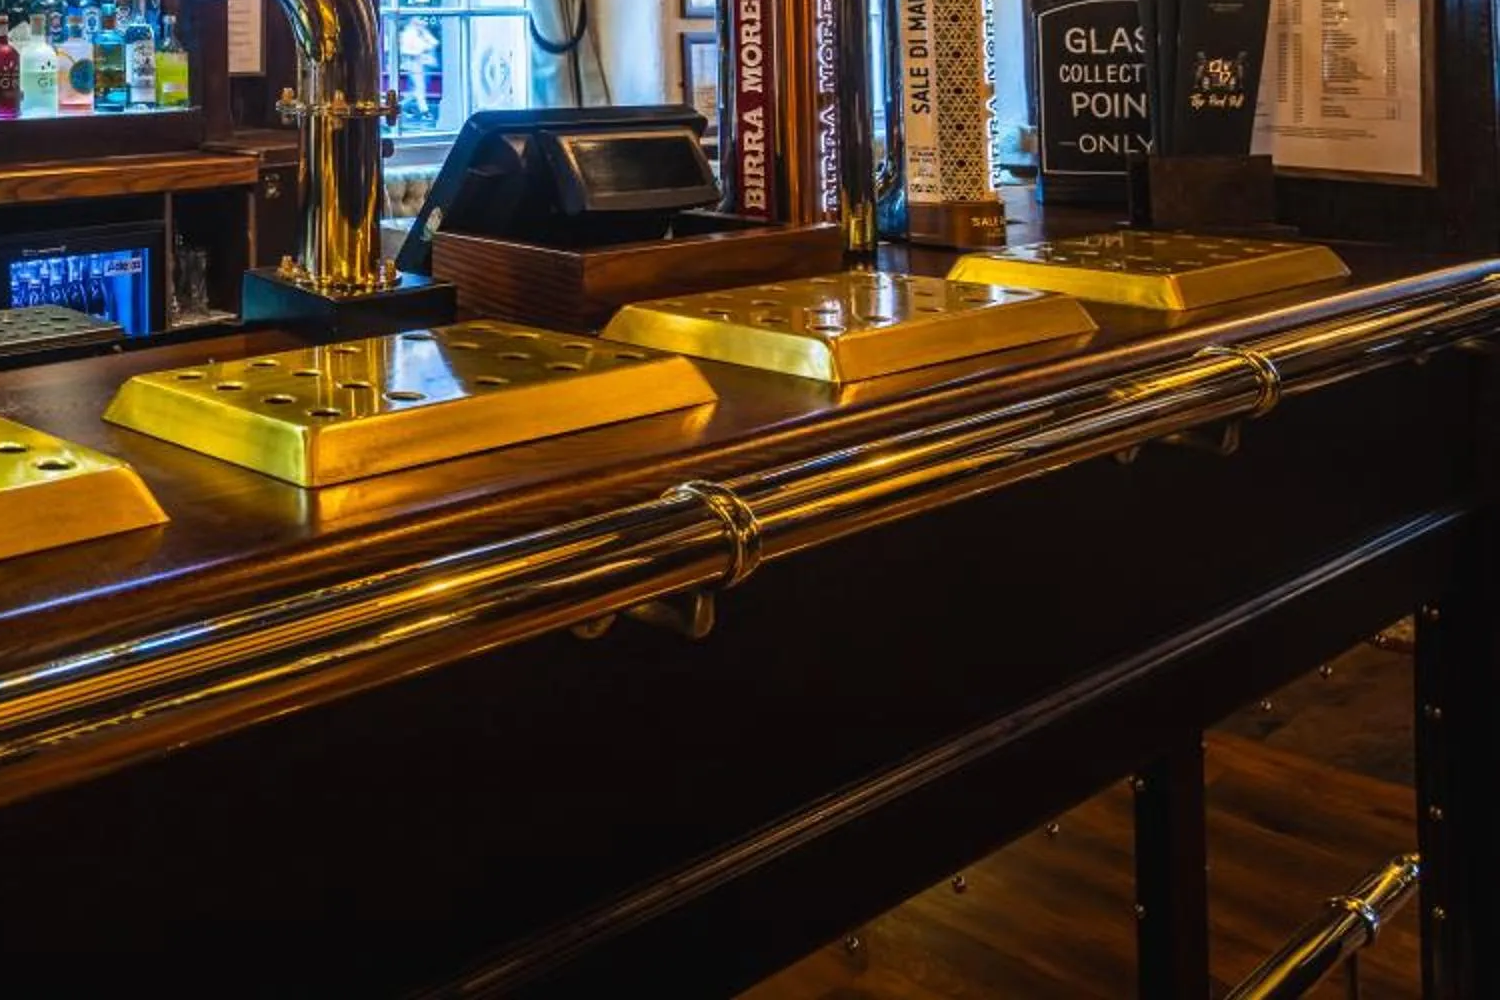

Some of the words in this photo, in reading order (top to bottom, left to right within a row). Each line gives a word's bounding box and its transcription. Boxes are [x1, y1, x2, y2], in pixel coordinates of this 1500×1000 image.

[907, 39, 929, 59] DI
[1064, 26, 1147, 55] GLAS
[1059, 63, 1148, 84] COLLECT
[910, 66, 931, 115] SALE
[1071, 90, 1148, 119] POIN
[743, 106, 765, 210] BIRRA
[1078, 133, 1155, 155] ONLY
